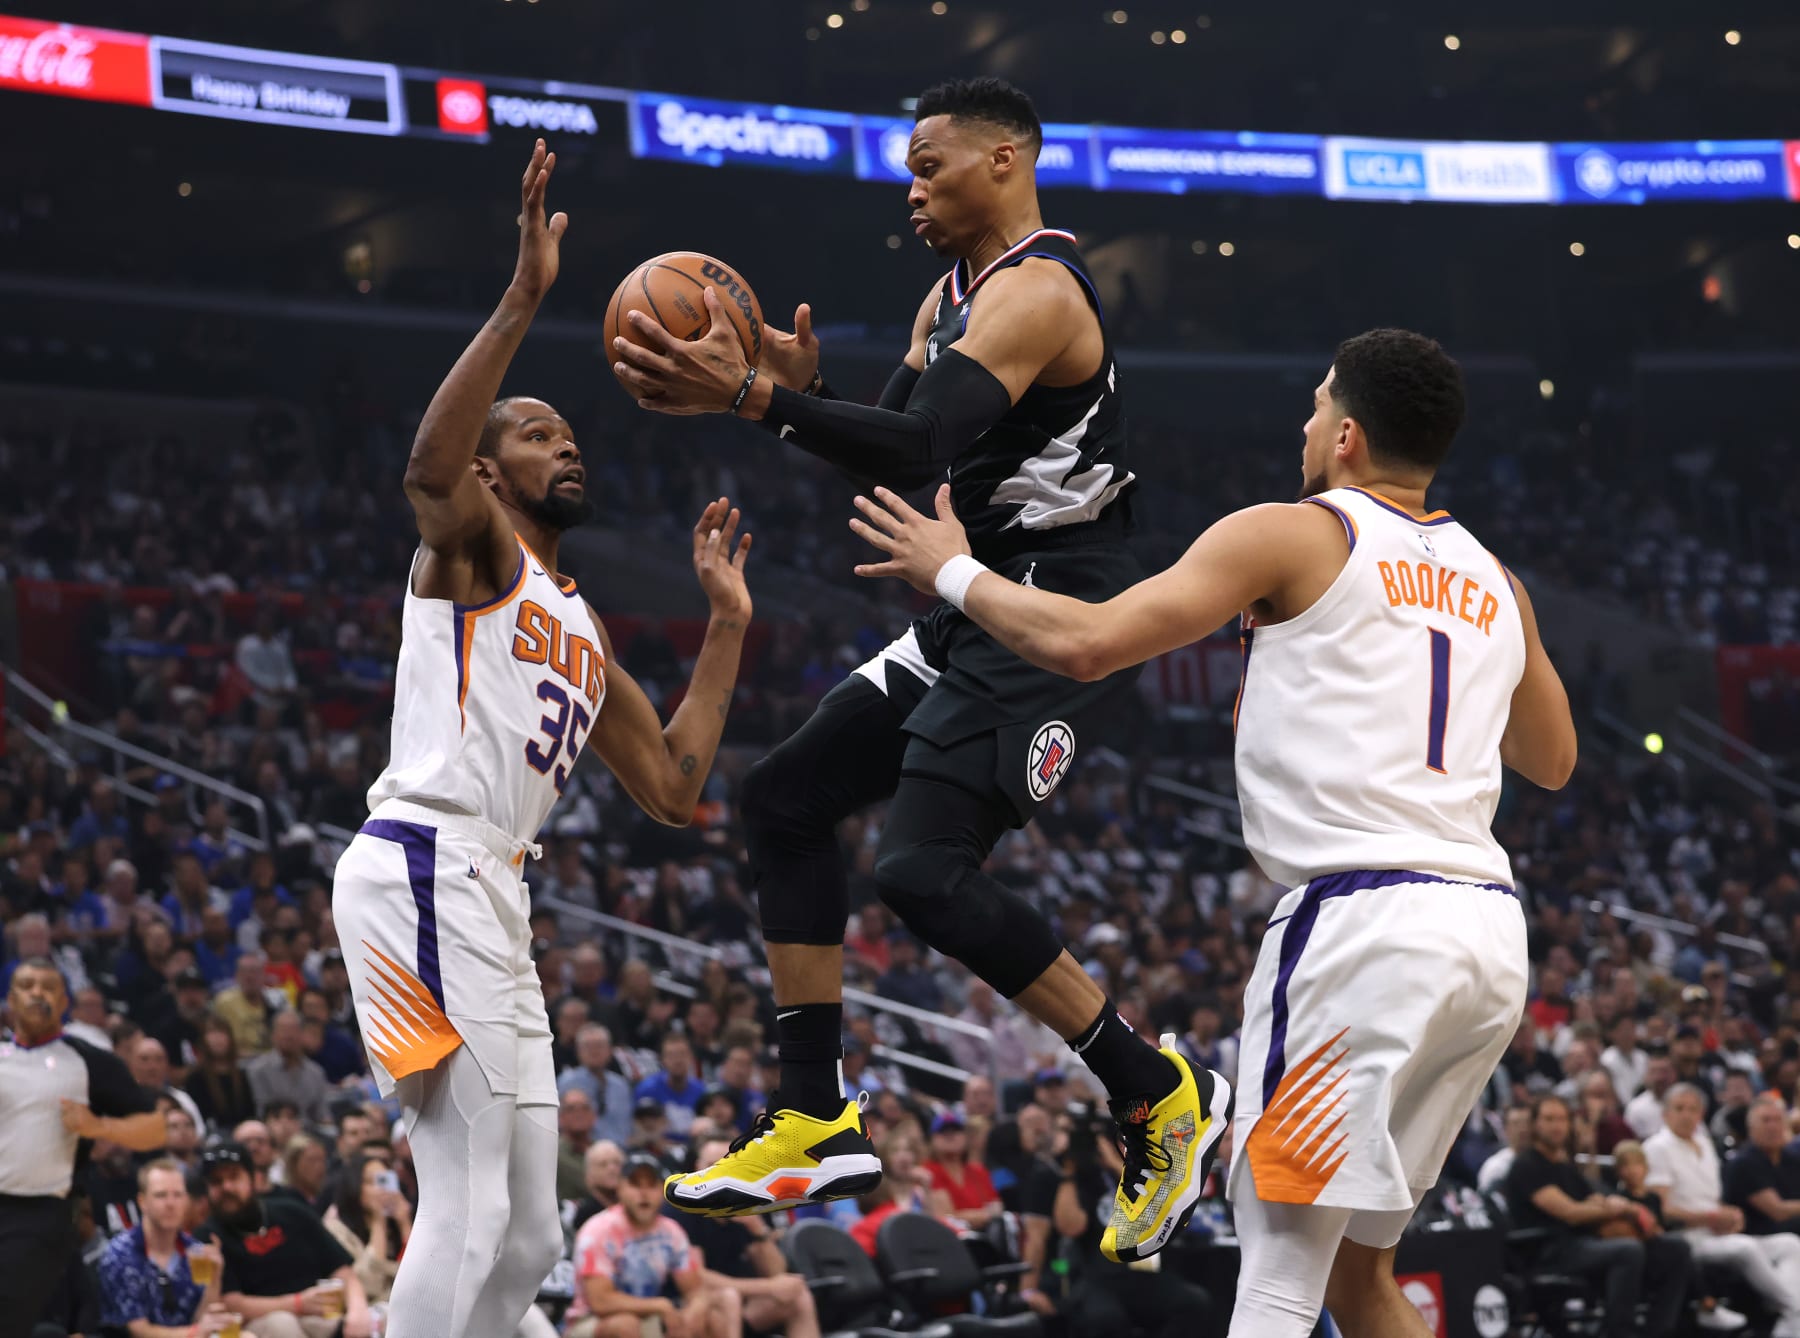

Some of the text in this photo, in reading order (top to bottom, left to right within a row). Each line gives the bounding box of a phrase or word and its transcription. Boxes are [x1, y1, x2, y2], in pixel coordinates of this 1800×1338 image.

[191, 73, 350, 119] Happy Birthday
[488, 95, 598, 135] TOYOTA
[657, 100, 831, 160] Spectrum
[1108, 146, 1317, 178] AMERICAN EXPRESS
[1347, 153, 1420, 186] UCLA
[1617, 159, 1767, 188] crypto.com
[1377, 560, 1499, 637] BOOKER
[1426, 625, 1451, 775] 1
[524, 679, 591, 797] 35
